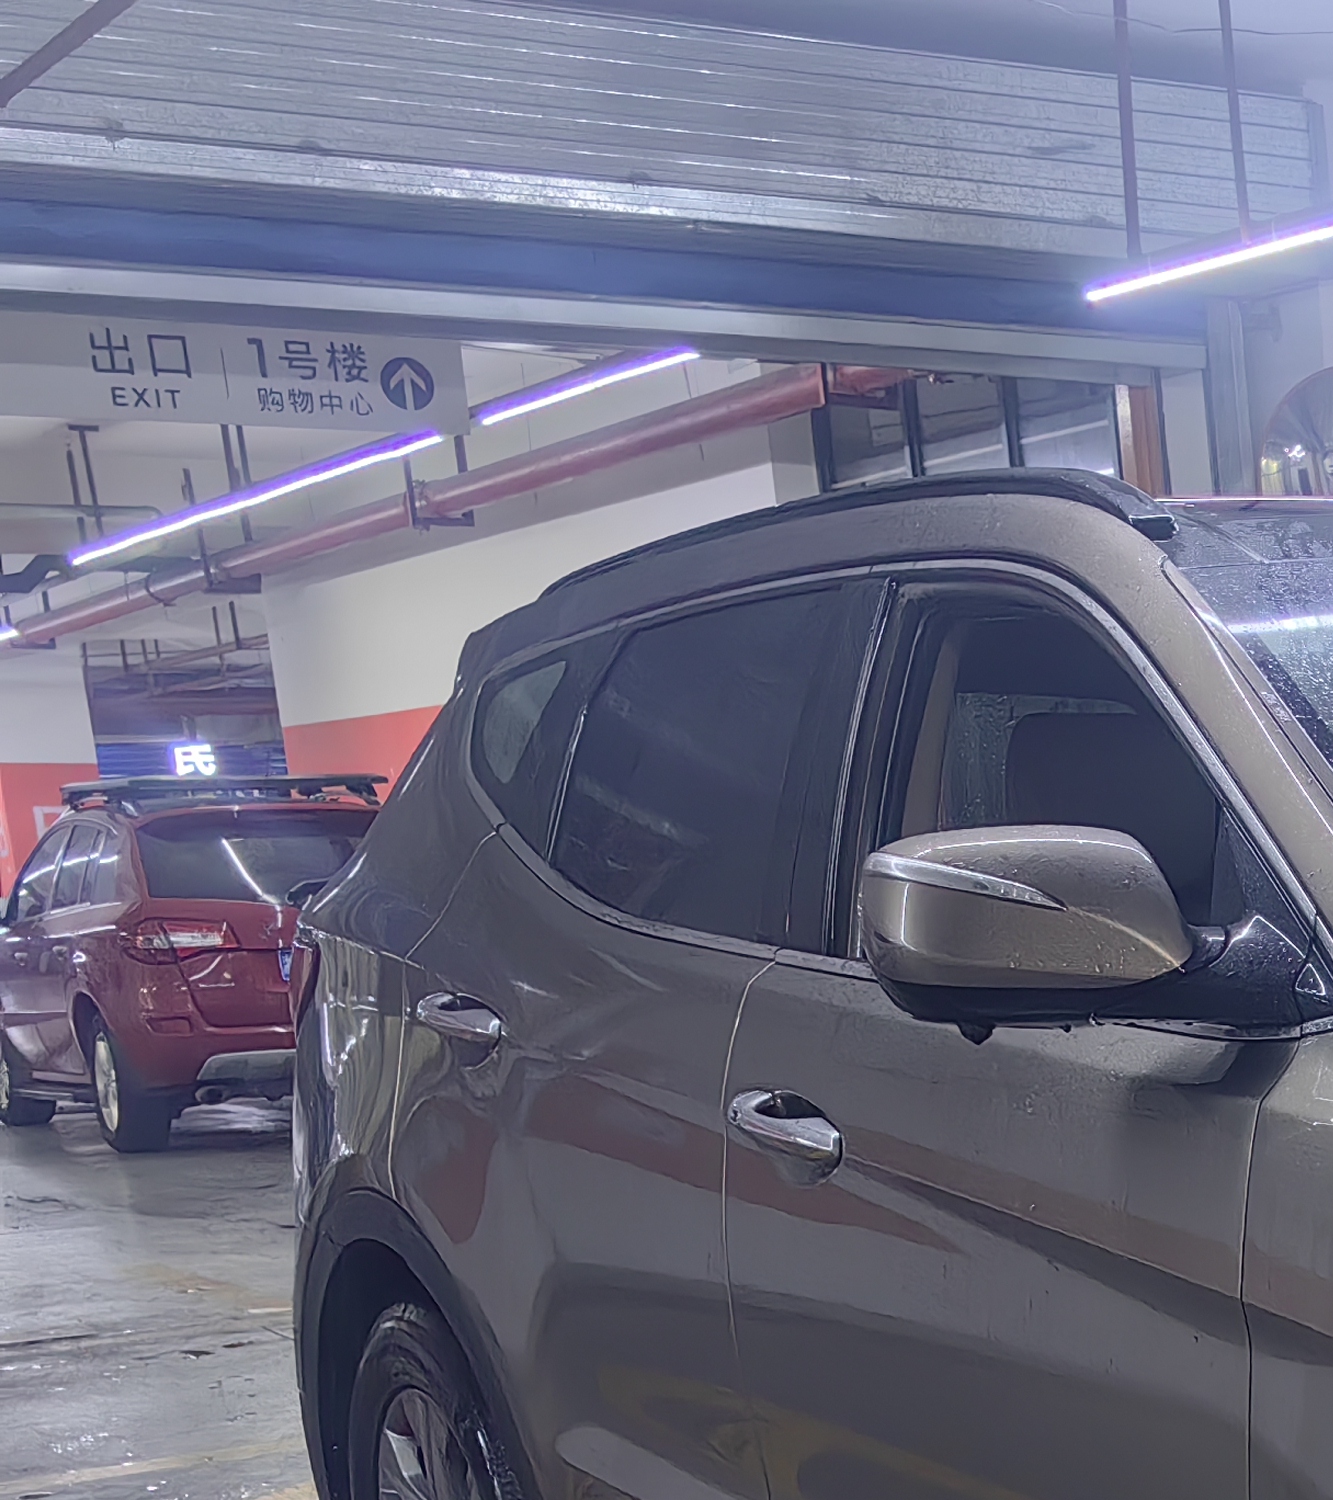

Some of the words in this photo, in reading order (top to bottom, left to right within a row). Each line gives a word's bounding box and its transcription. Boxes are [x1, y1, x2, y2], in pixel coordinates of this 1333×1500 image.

[89, 327, 193, 379] 出口
[246, 336, 370, 384] 1号楼
[111, 386, 181, 409] EXIT
[257, 387, 374, 417] 购物中心
